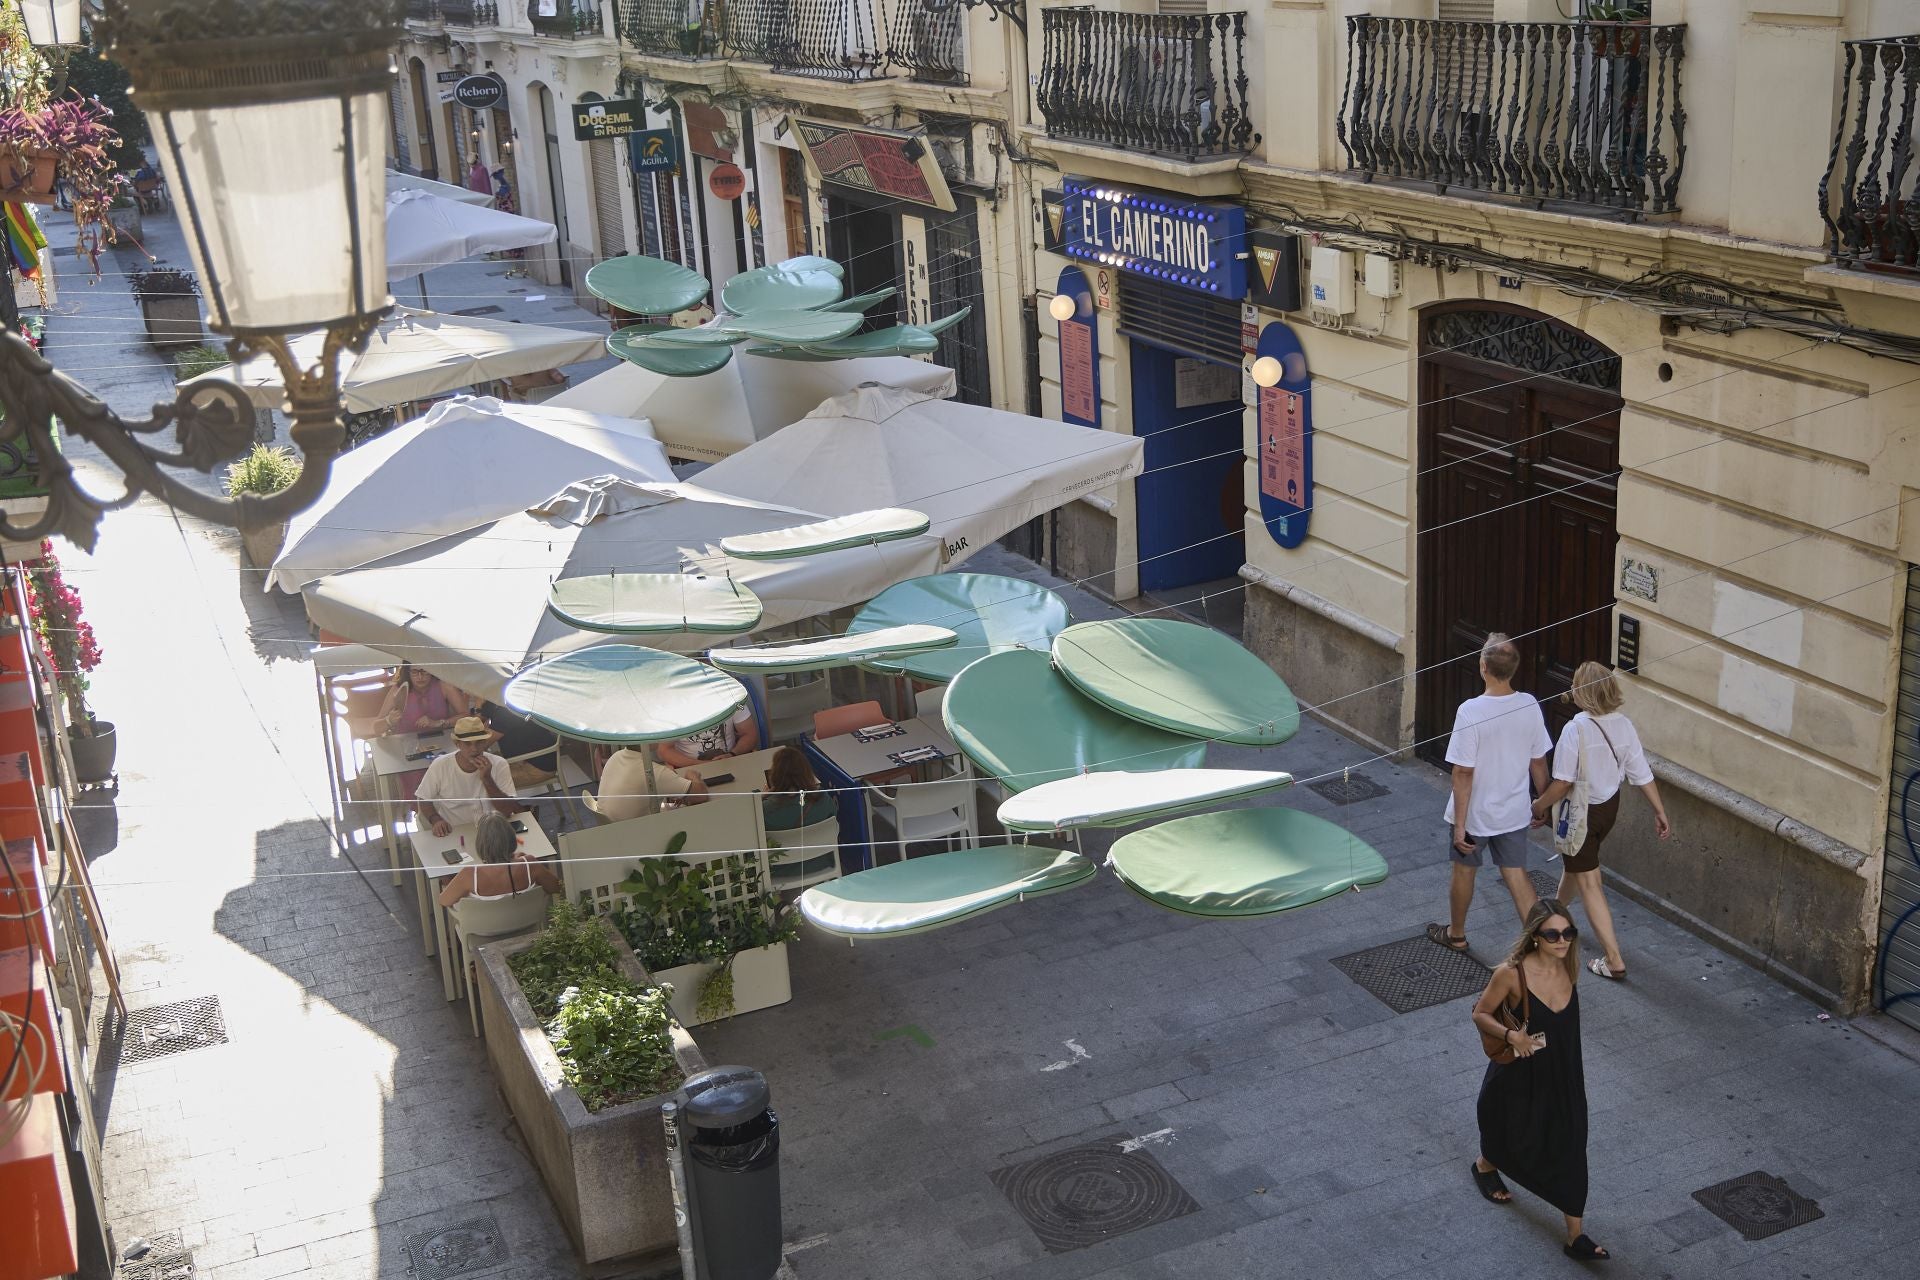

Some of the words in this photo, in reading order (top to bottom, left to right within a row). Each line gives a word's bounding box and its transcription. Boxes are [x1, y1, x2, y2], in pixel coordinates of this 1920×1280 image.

[459, 86, 499, 97] Reborn
[1083, 199, 1103, 247] EL
[1110, 206, 1209, 273] CAMERINO
[1062, 478, 1094, 494] CERVECEROS
[949, 536, 969, 557] BAR
